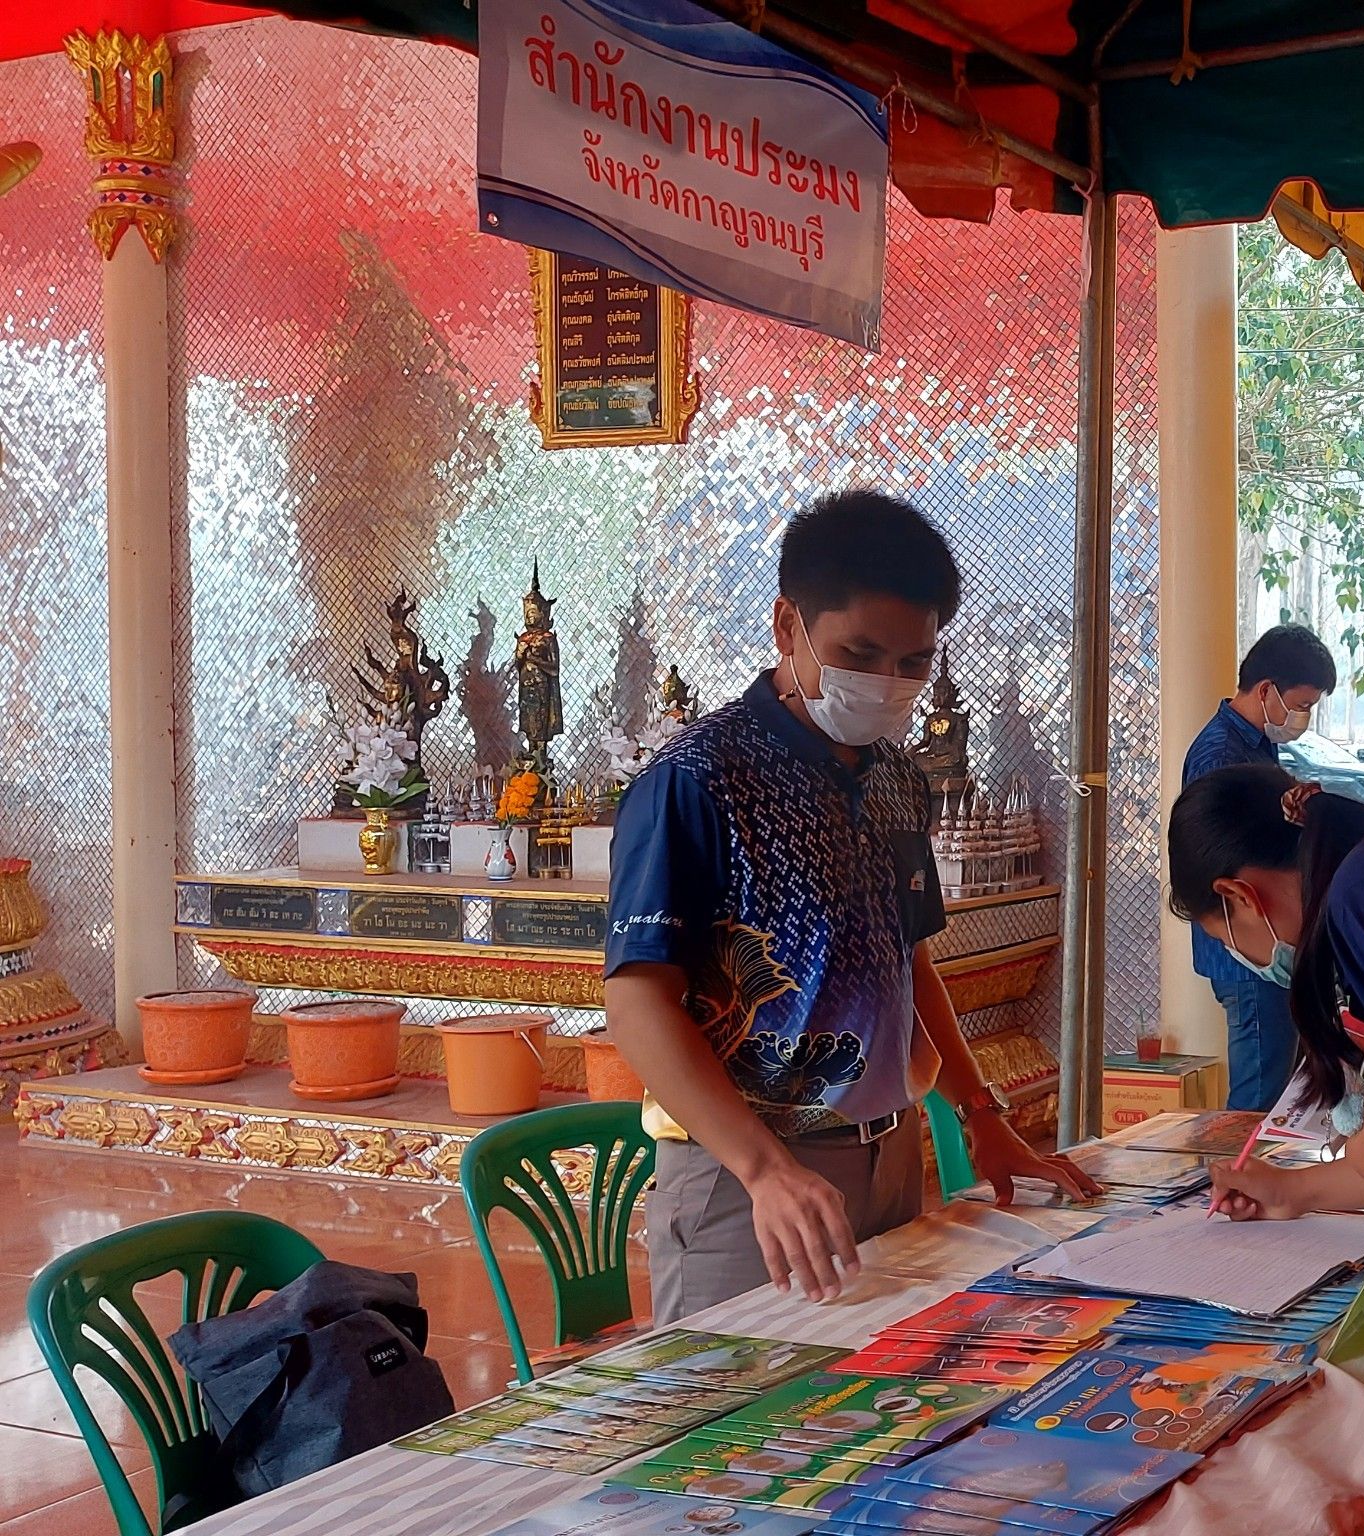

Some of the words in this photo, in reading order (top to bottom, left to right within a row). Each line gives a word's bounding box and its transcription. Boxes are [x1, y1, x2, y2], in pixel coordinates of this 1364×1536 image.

[524, 15, 861, 213] สำนักงานประมง
[581, 129, 825, 272] จังหวัดกาญจนบุรี
[562, 315, 593, 329] คุณมงคล
